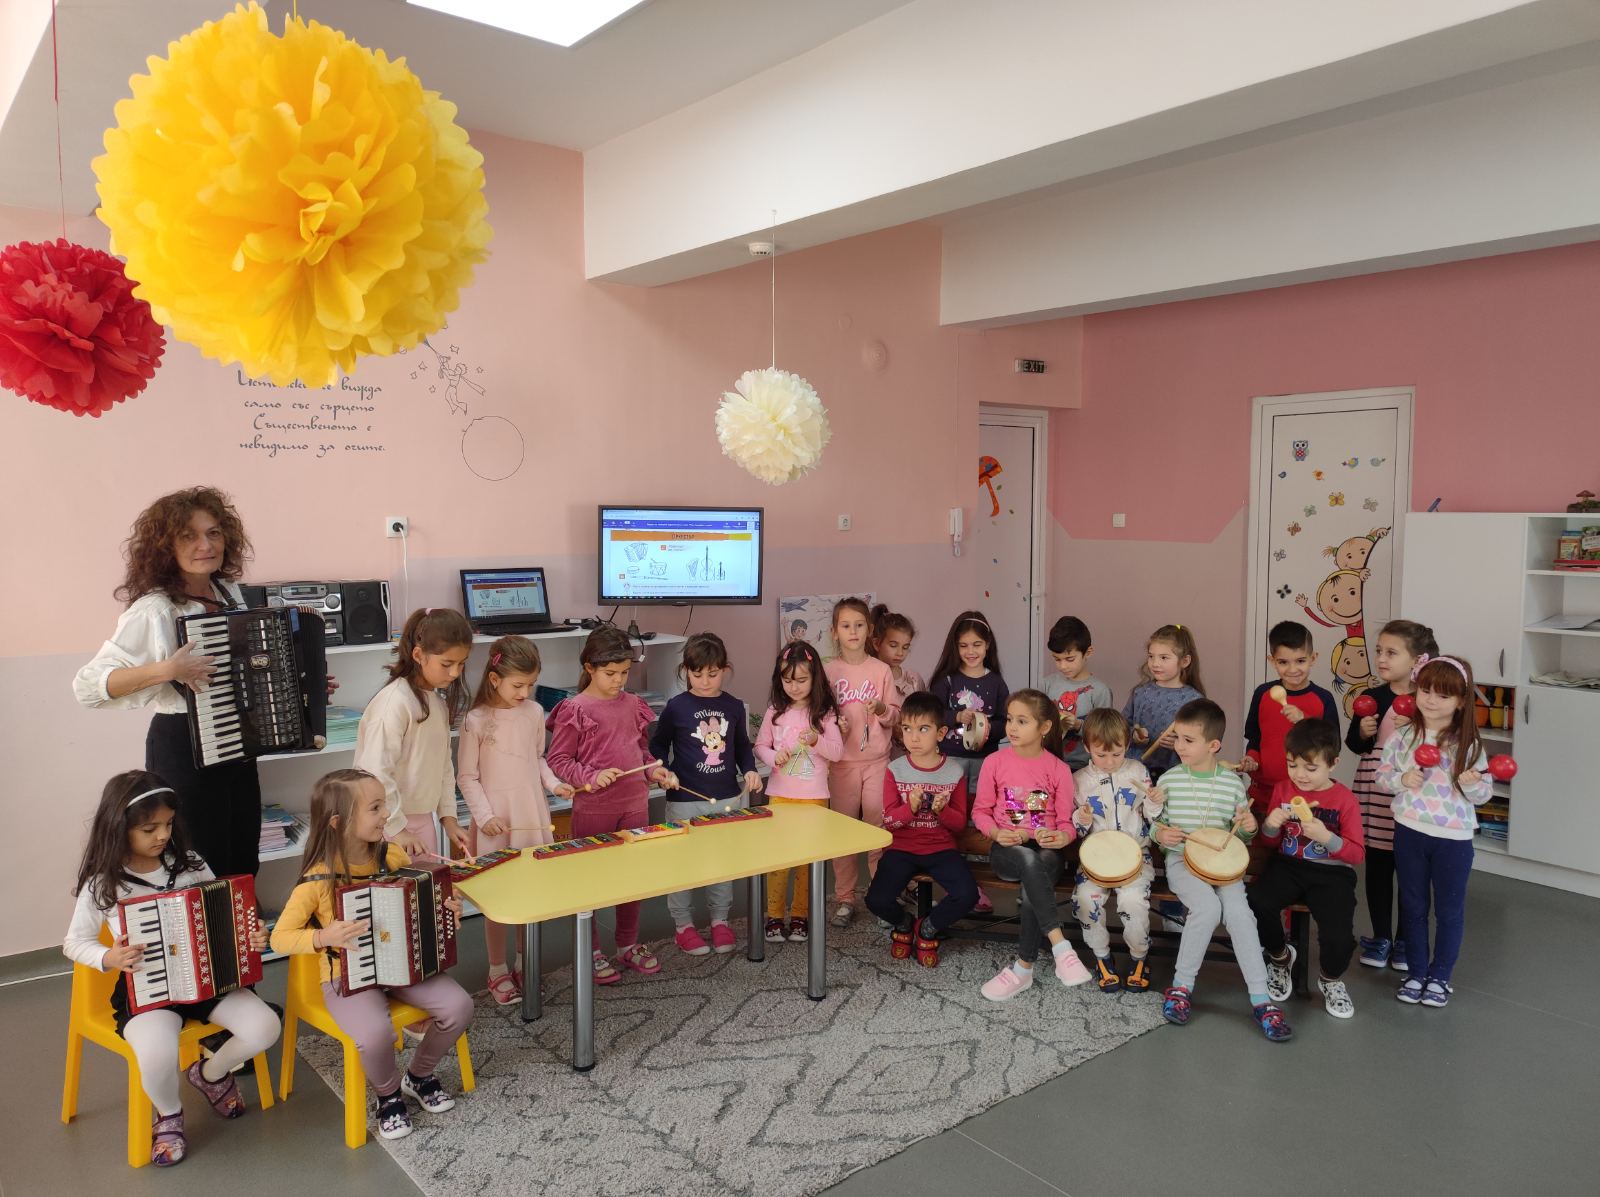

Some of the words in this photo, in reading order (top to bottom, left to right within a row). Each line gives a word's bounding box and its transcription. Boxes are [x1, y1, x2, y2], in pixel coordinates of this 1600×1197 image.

[1023, 360, 1044, 372] EXIT
[244, 400, 282, 408] само
[292, 402, 310, 410] със
[320, 403, 375, 420] сърцето
[253, 412, 357, 433] Същественото
[239, 434, 309, 458] невидимо
[316, 444, 335, 458] за
[835, 678, 880, 705] Barbie
[694, 709, 725, 719] Minnie
[696, 762, 726, 774] Mouse
